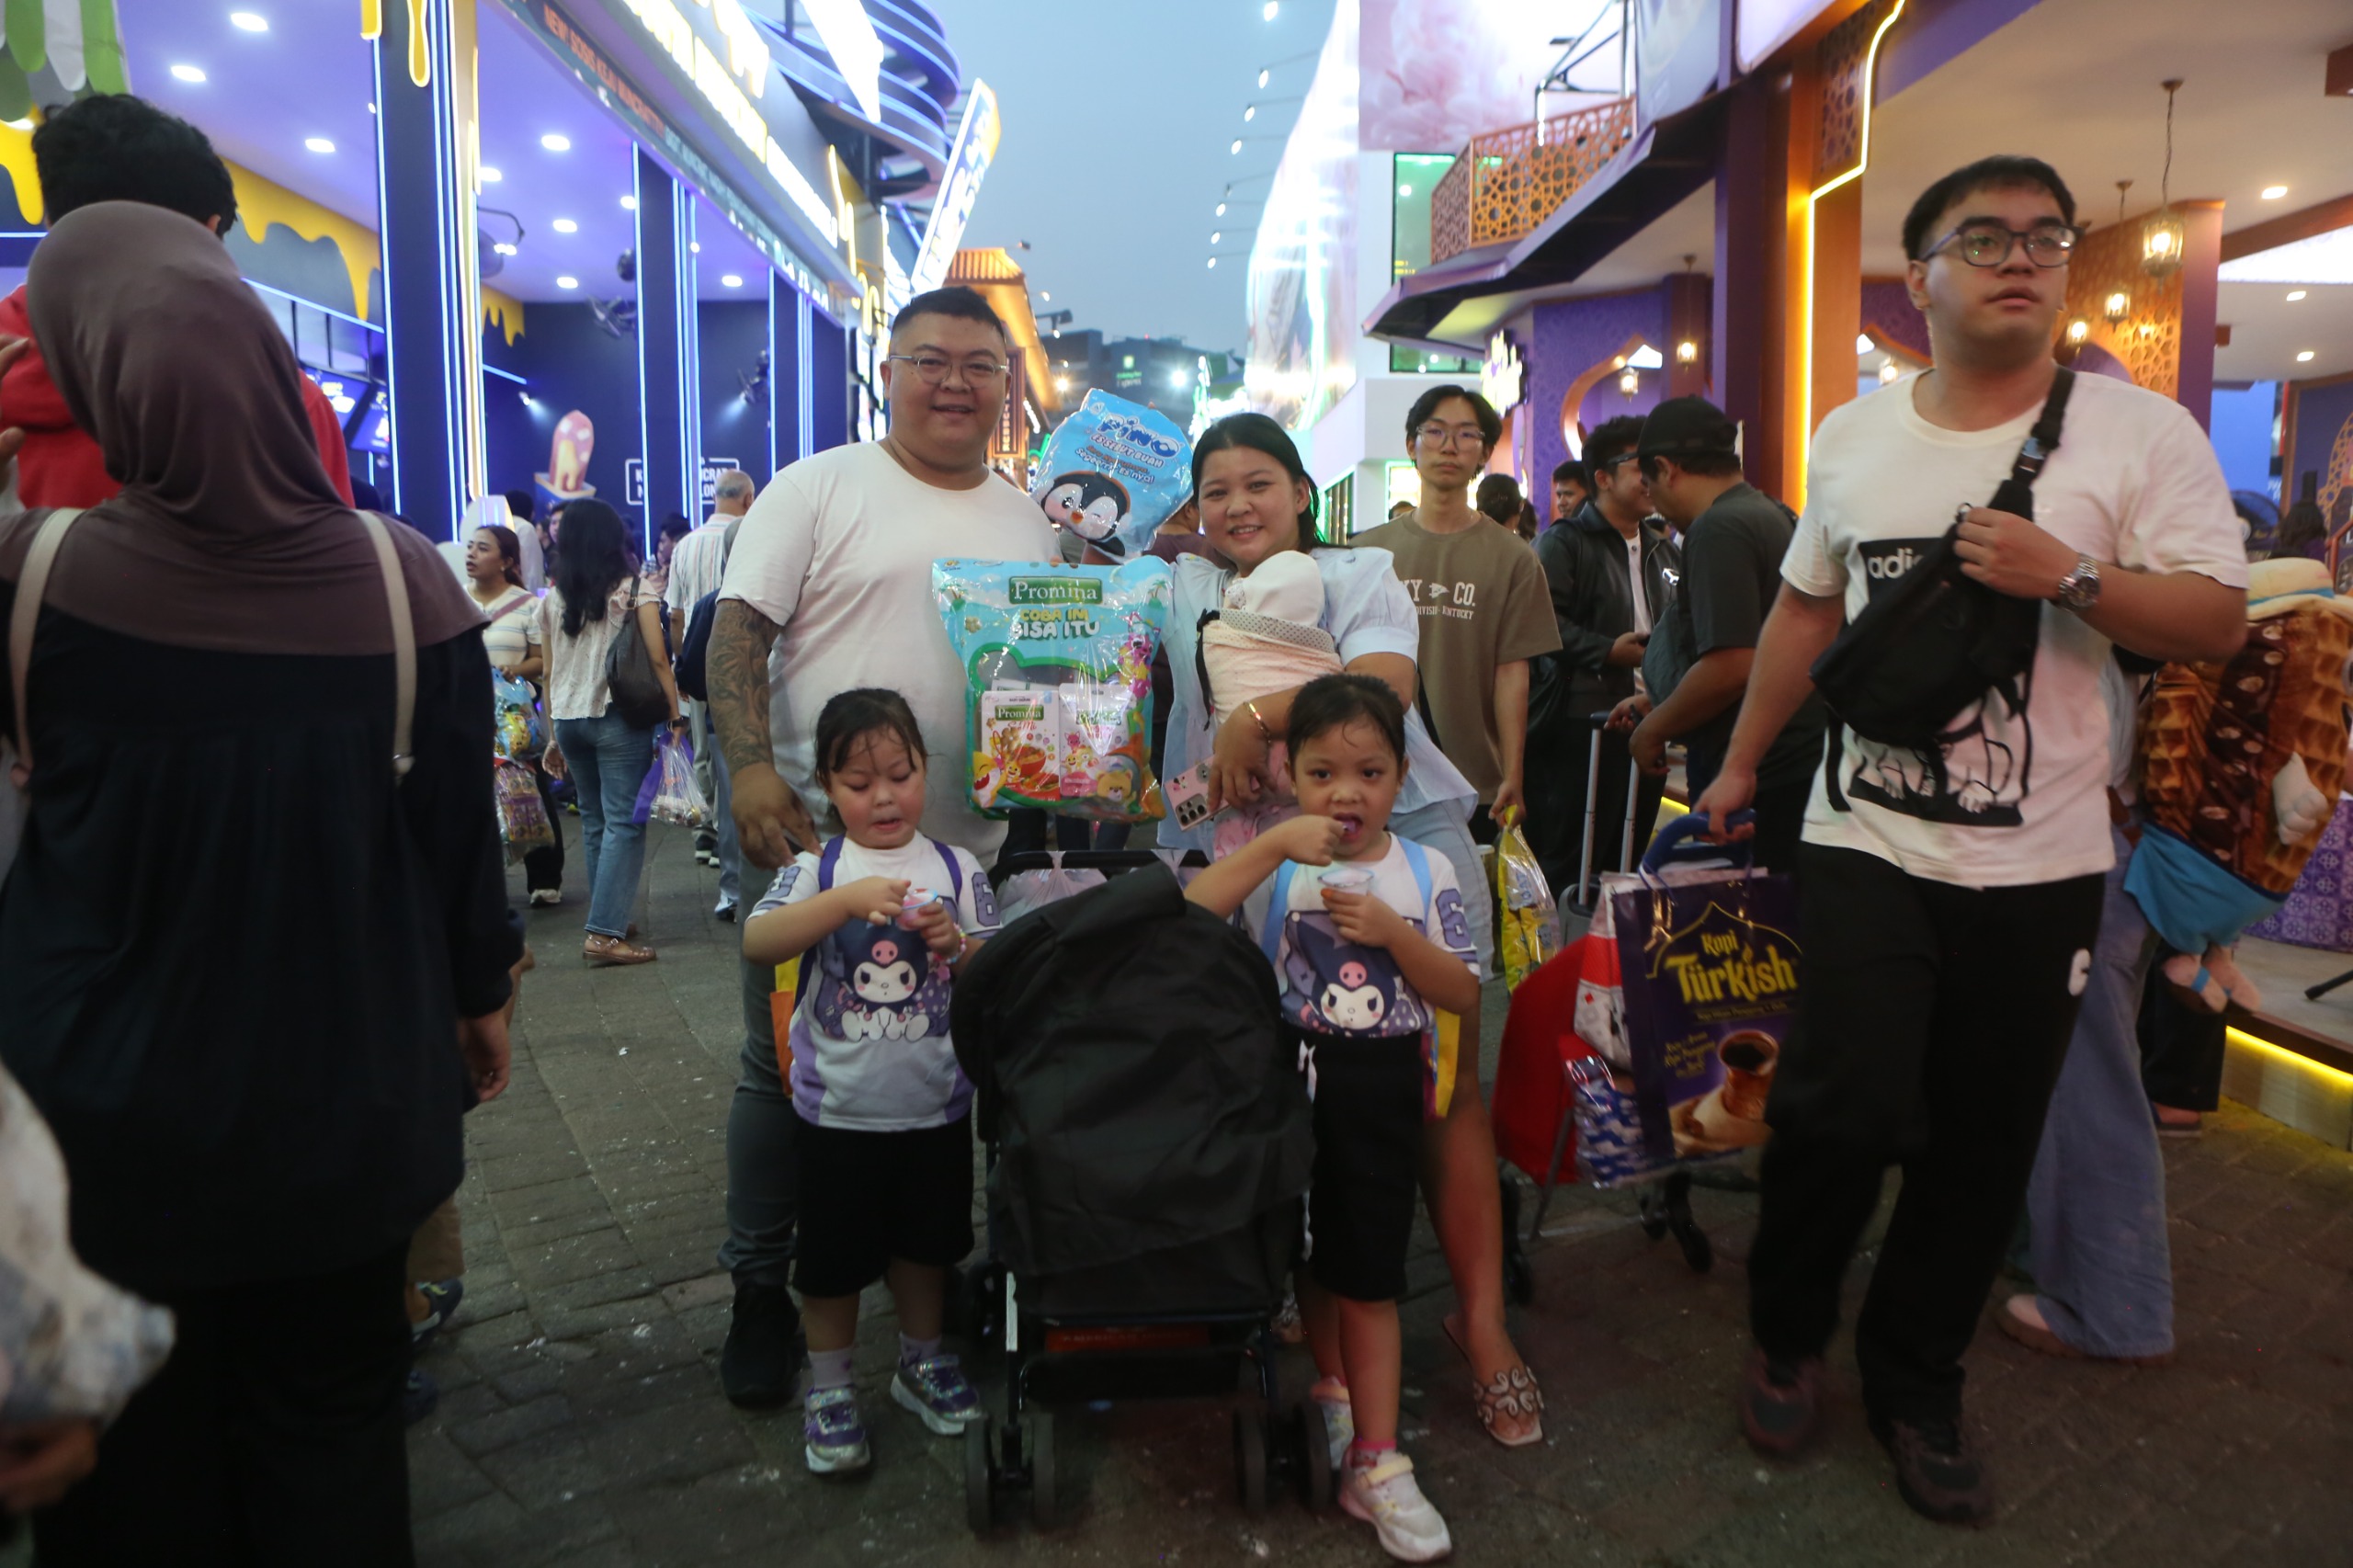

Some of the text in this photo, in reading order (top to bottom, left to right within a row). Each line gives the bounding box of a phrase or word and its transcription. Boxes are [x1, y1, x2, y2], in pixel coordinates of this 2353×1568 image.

[1133, 450, 1164, 468] BUAH
[1867, 548, 1925, 579] adi
[1014, 580, 1097, 600] Promina
[1453, 581, 1476, 607] CO.
[1019, 608, 1063, 622] COBA
[1010, 620, 1100, 639] BISA ITU
[1701, 929, 1739, 957] Kopi
